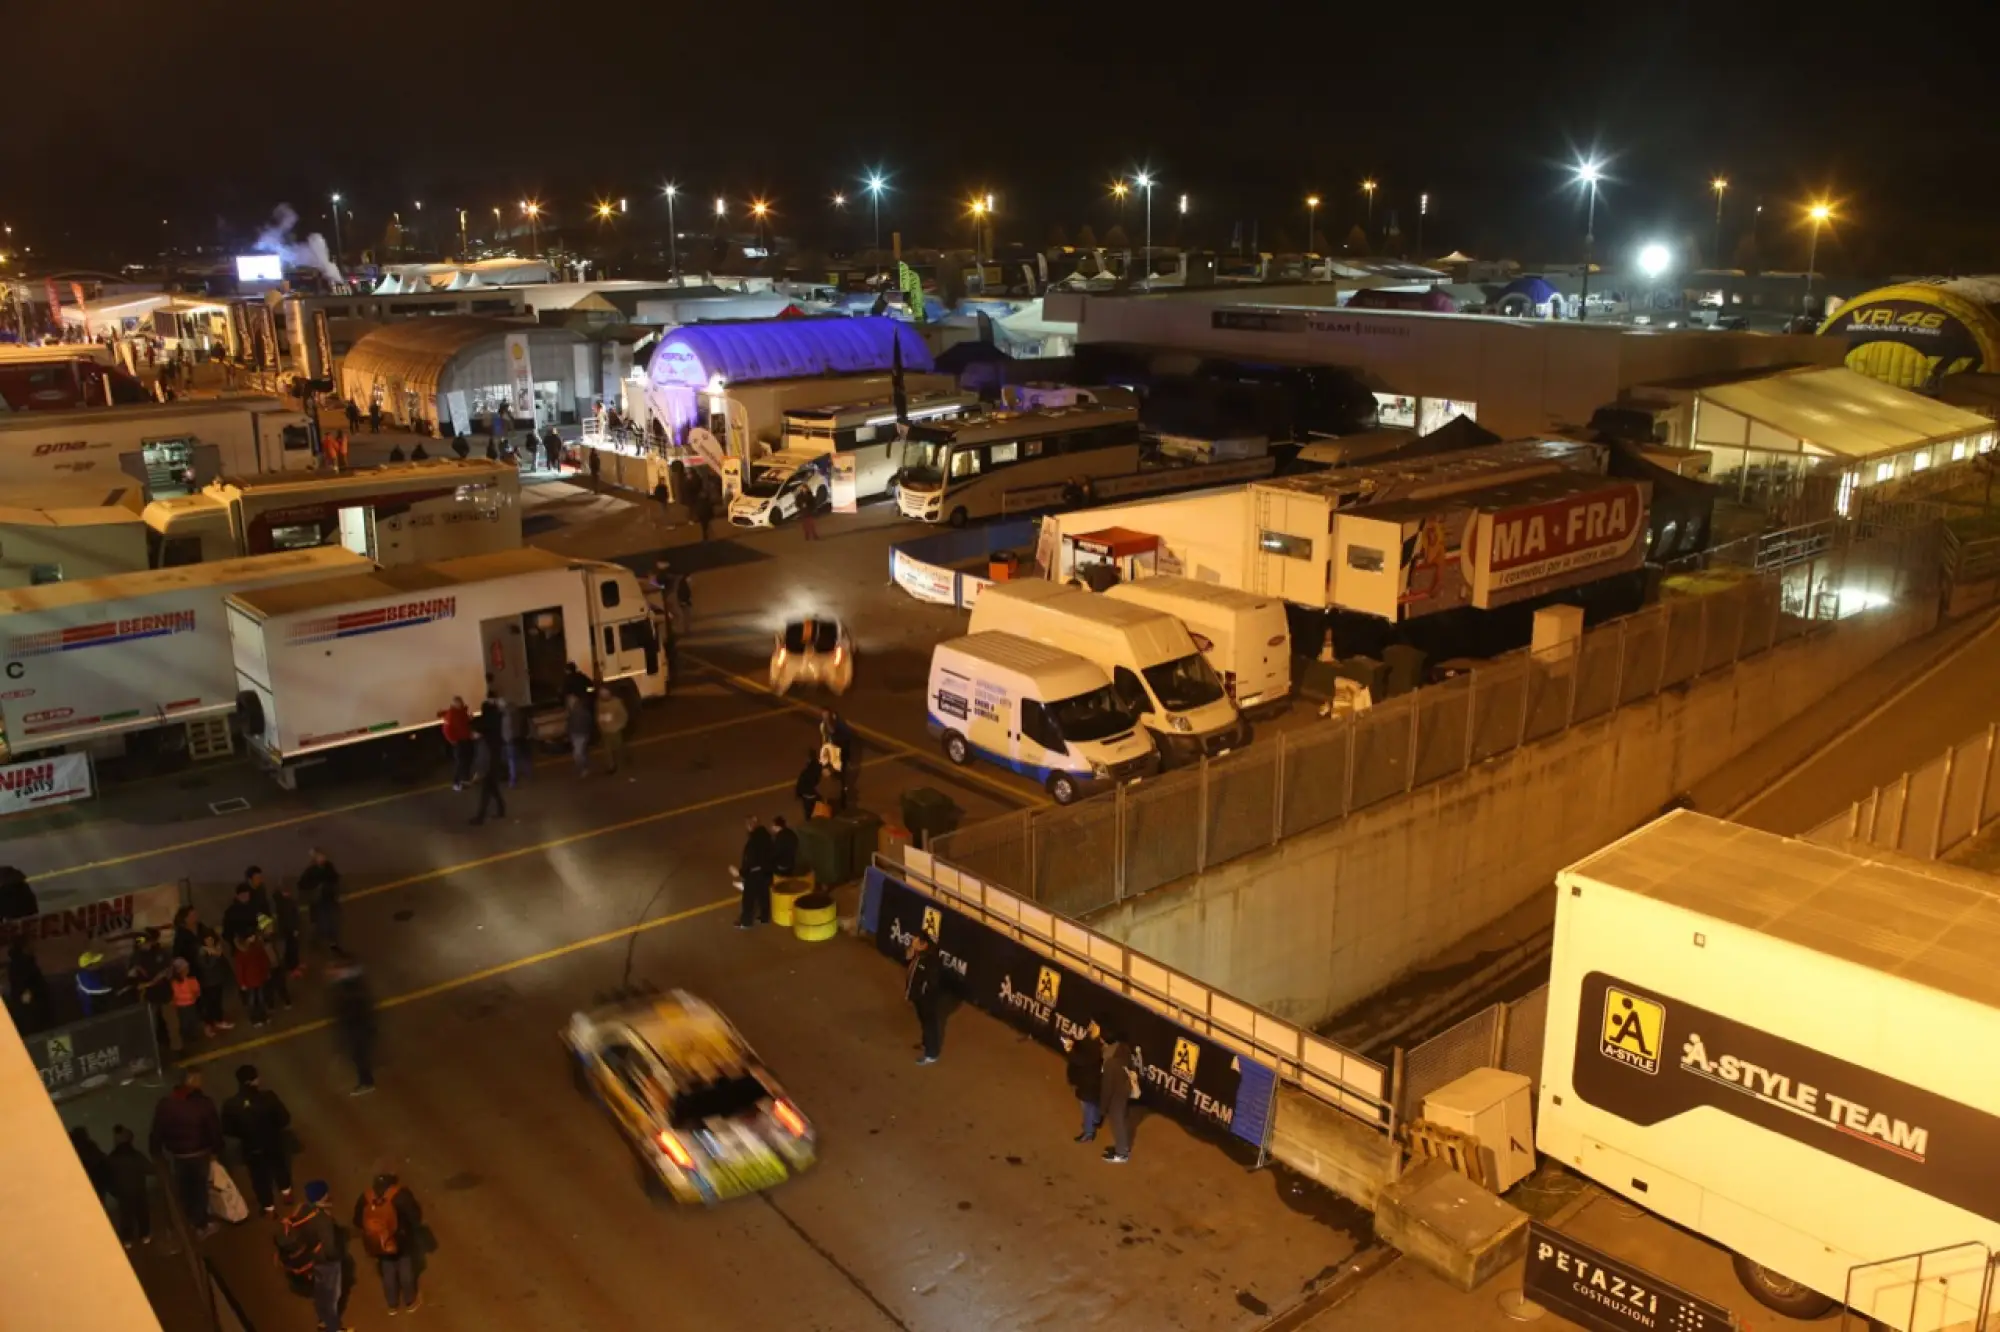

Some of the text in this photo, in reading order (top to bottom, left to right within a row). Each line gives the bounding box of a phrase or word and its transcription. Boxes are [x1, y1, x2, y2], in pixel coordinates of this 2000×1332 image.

[118, 610, 195, 634] BERNINI
[387, 596, 456, 621] BERNINI
[6, 661, 25, 679] C
[14, 779, 54, 799] rally
[1603, 1044, 1657, 1073] A-STYLE
[1192, 1087, 1235, 1125] TEAM
[1680, 1033, 1929, 1155] A-STYLE TEAM
[1537, 1242, 1659, 1314] PETAZZI
[1572, 1281, 1656, 1329] COSTRUZIONI
